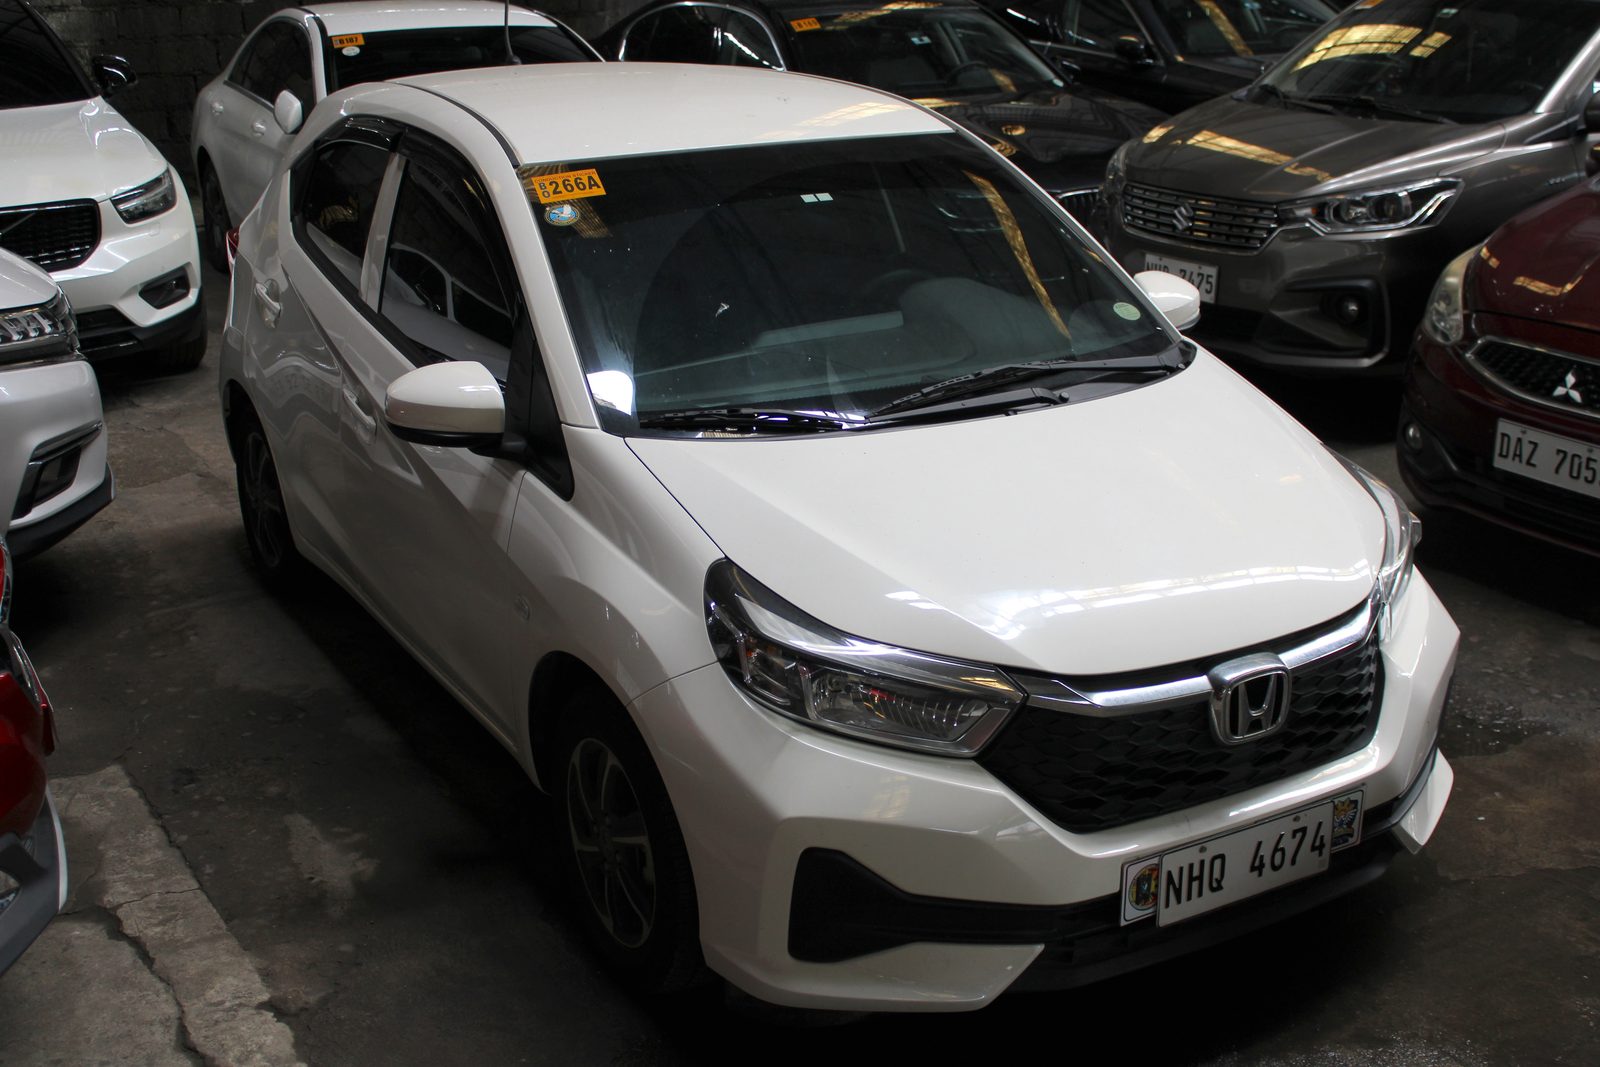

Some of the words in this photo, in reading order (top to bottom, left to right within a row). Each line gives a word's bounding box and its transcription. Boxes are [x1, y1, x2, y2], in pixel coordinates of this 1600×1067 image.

[549, 175, 601, 195] 266A
[1498, 432, 1539, 468] DAZ
[1554, 448, 1600, 485] 705
[1165, 852, 1226, 909] NHQ
[1250, 820, 1326, 878] 4674
